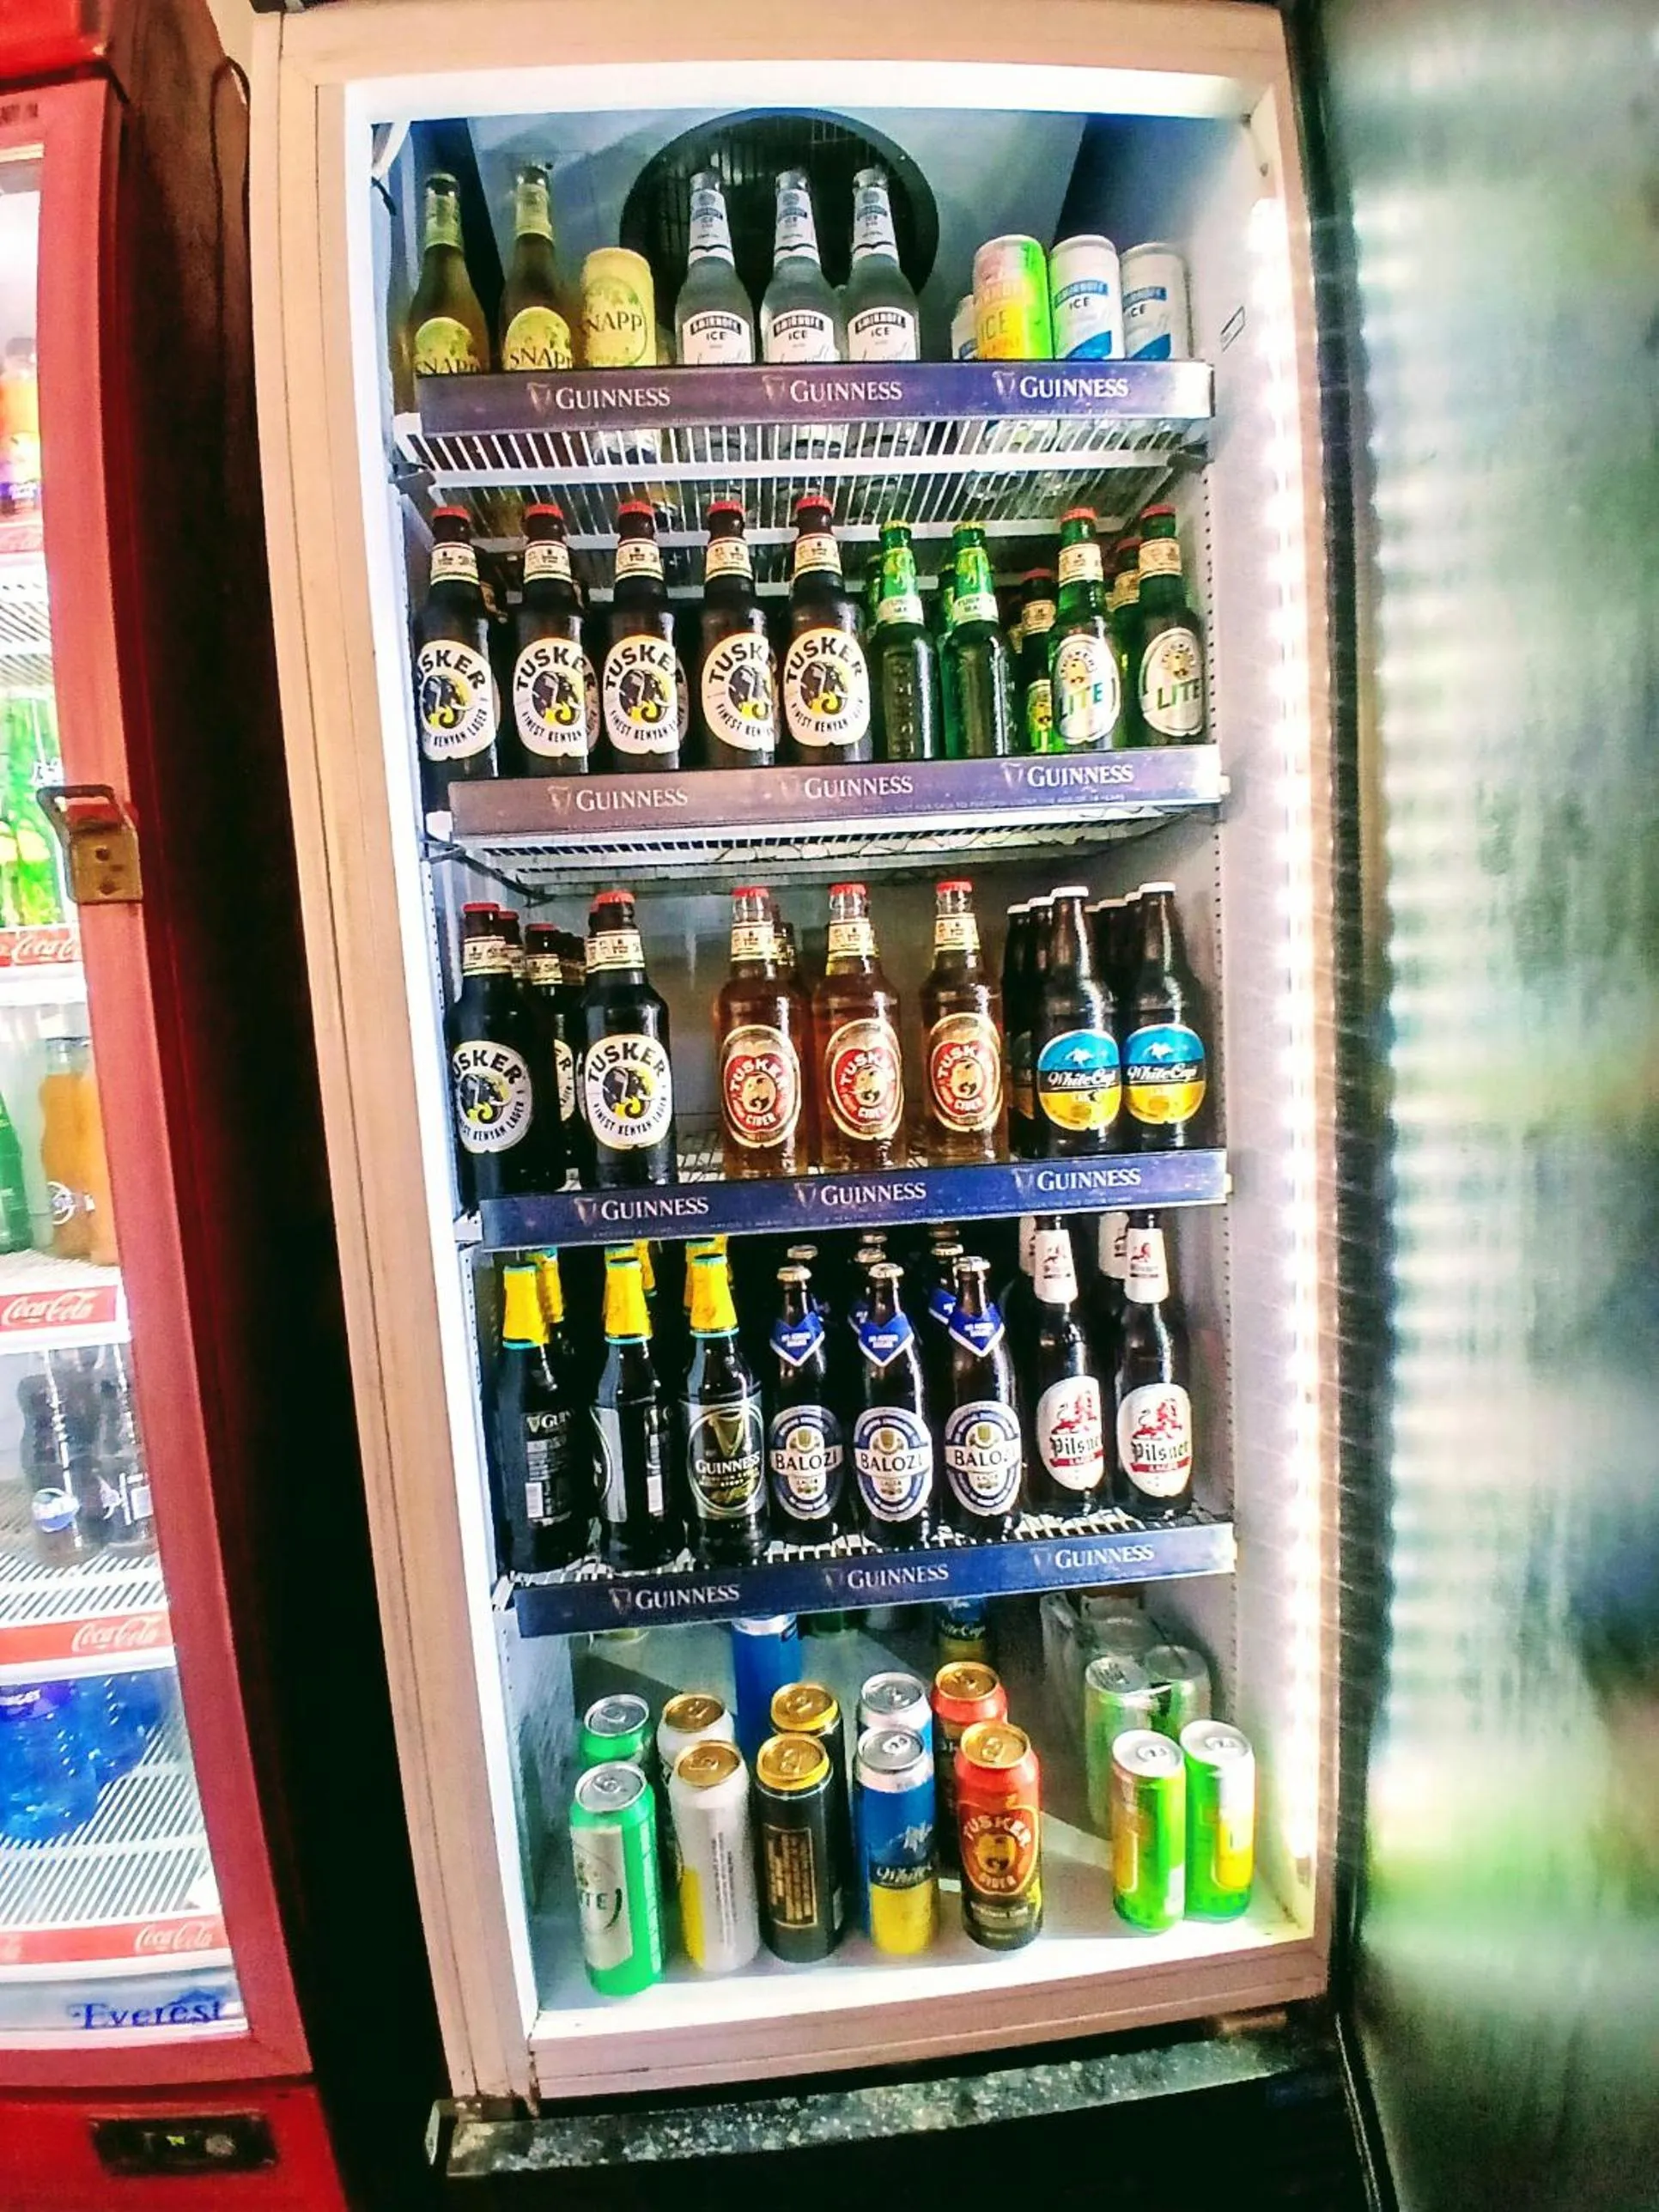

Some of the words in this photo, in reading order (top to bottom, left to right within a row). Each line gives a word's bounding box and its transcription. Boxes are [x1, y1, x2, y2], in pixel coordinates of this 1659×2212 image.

[1069, 297, 1090, 310] ICE
[706, 331, 726, 341] ICE
[788, 330, 808, 340] ICE
[872, 327, 890, 337] ICE
[556, 386, 671, 410] GUINNESS
[789, 380, 902, 403] GUINNESS
[1019, 376, 1128, 398] GUINNESS
[416, 649, 486, 690] SKER
[516, 647, 596, 691] TUSKER
[708, 642, 766, 684] TUSK
[786, 636, 862, 684] TUSKER
[1158, 678, 1200, 710] LITE
[804, 775, 914, 799] GUINNESS
[1027, 764, 1134, 787] GUINNESS
[576, 787, 688, 811] GUINNESS
[453, 1049, 522, 1085] USKER
[588, 1042, 665, 1084] TUSKER
[937, 1045, 979, 1079] TUSK
[1037, 1169, 1141, 1192] GUINNESS
[821, 1182, 927, 1206] GUINNESS
[601, 1197, 708, 1220] GUINNESS
[695, 1451, 761, 1475] GUINNESS
[775, 1450, 837, 1470] BALOZI
[860, 1453, 922, 1472] BALOZI
[954, 1449, 1008, 1467] BALO
[1054, 1544, 1155, 1569] GUINNESS
[847, 1565, 949, 1590] GUINNESS
[635, 1583, 740, 1610] GUINNESS
[963, 1815, 1031, 1848] TUSKER
